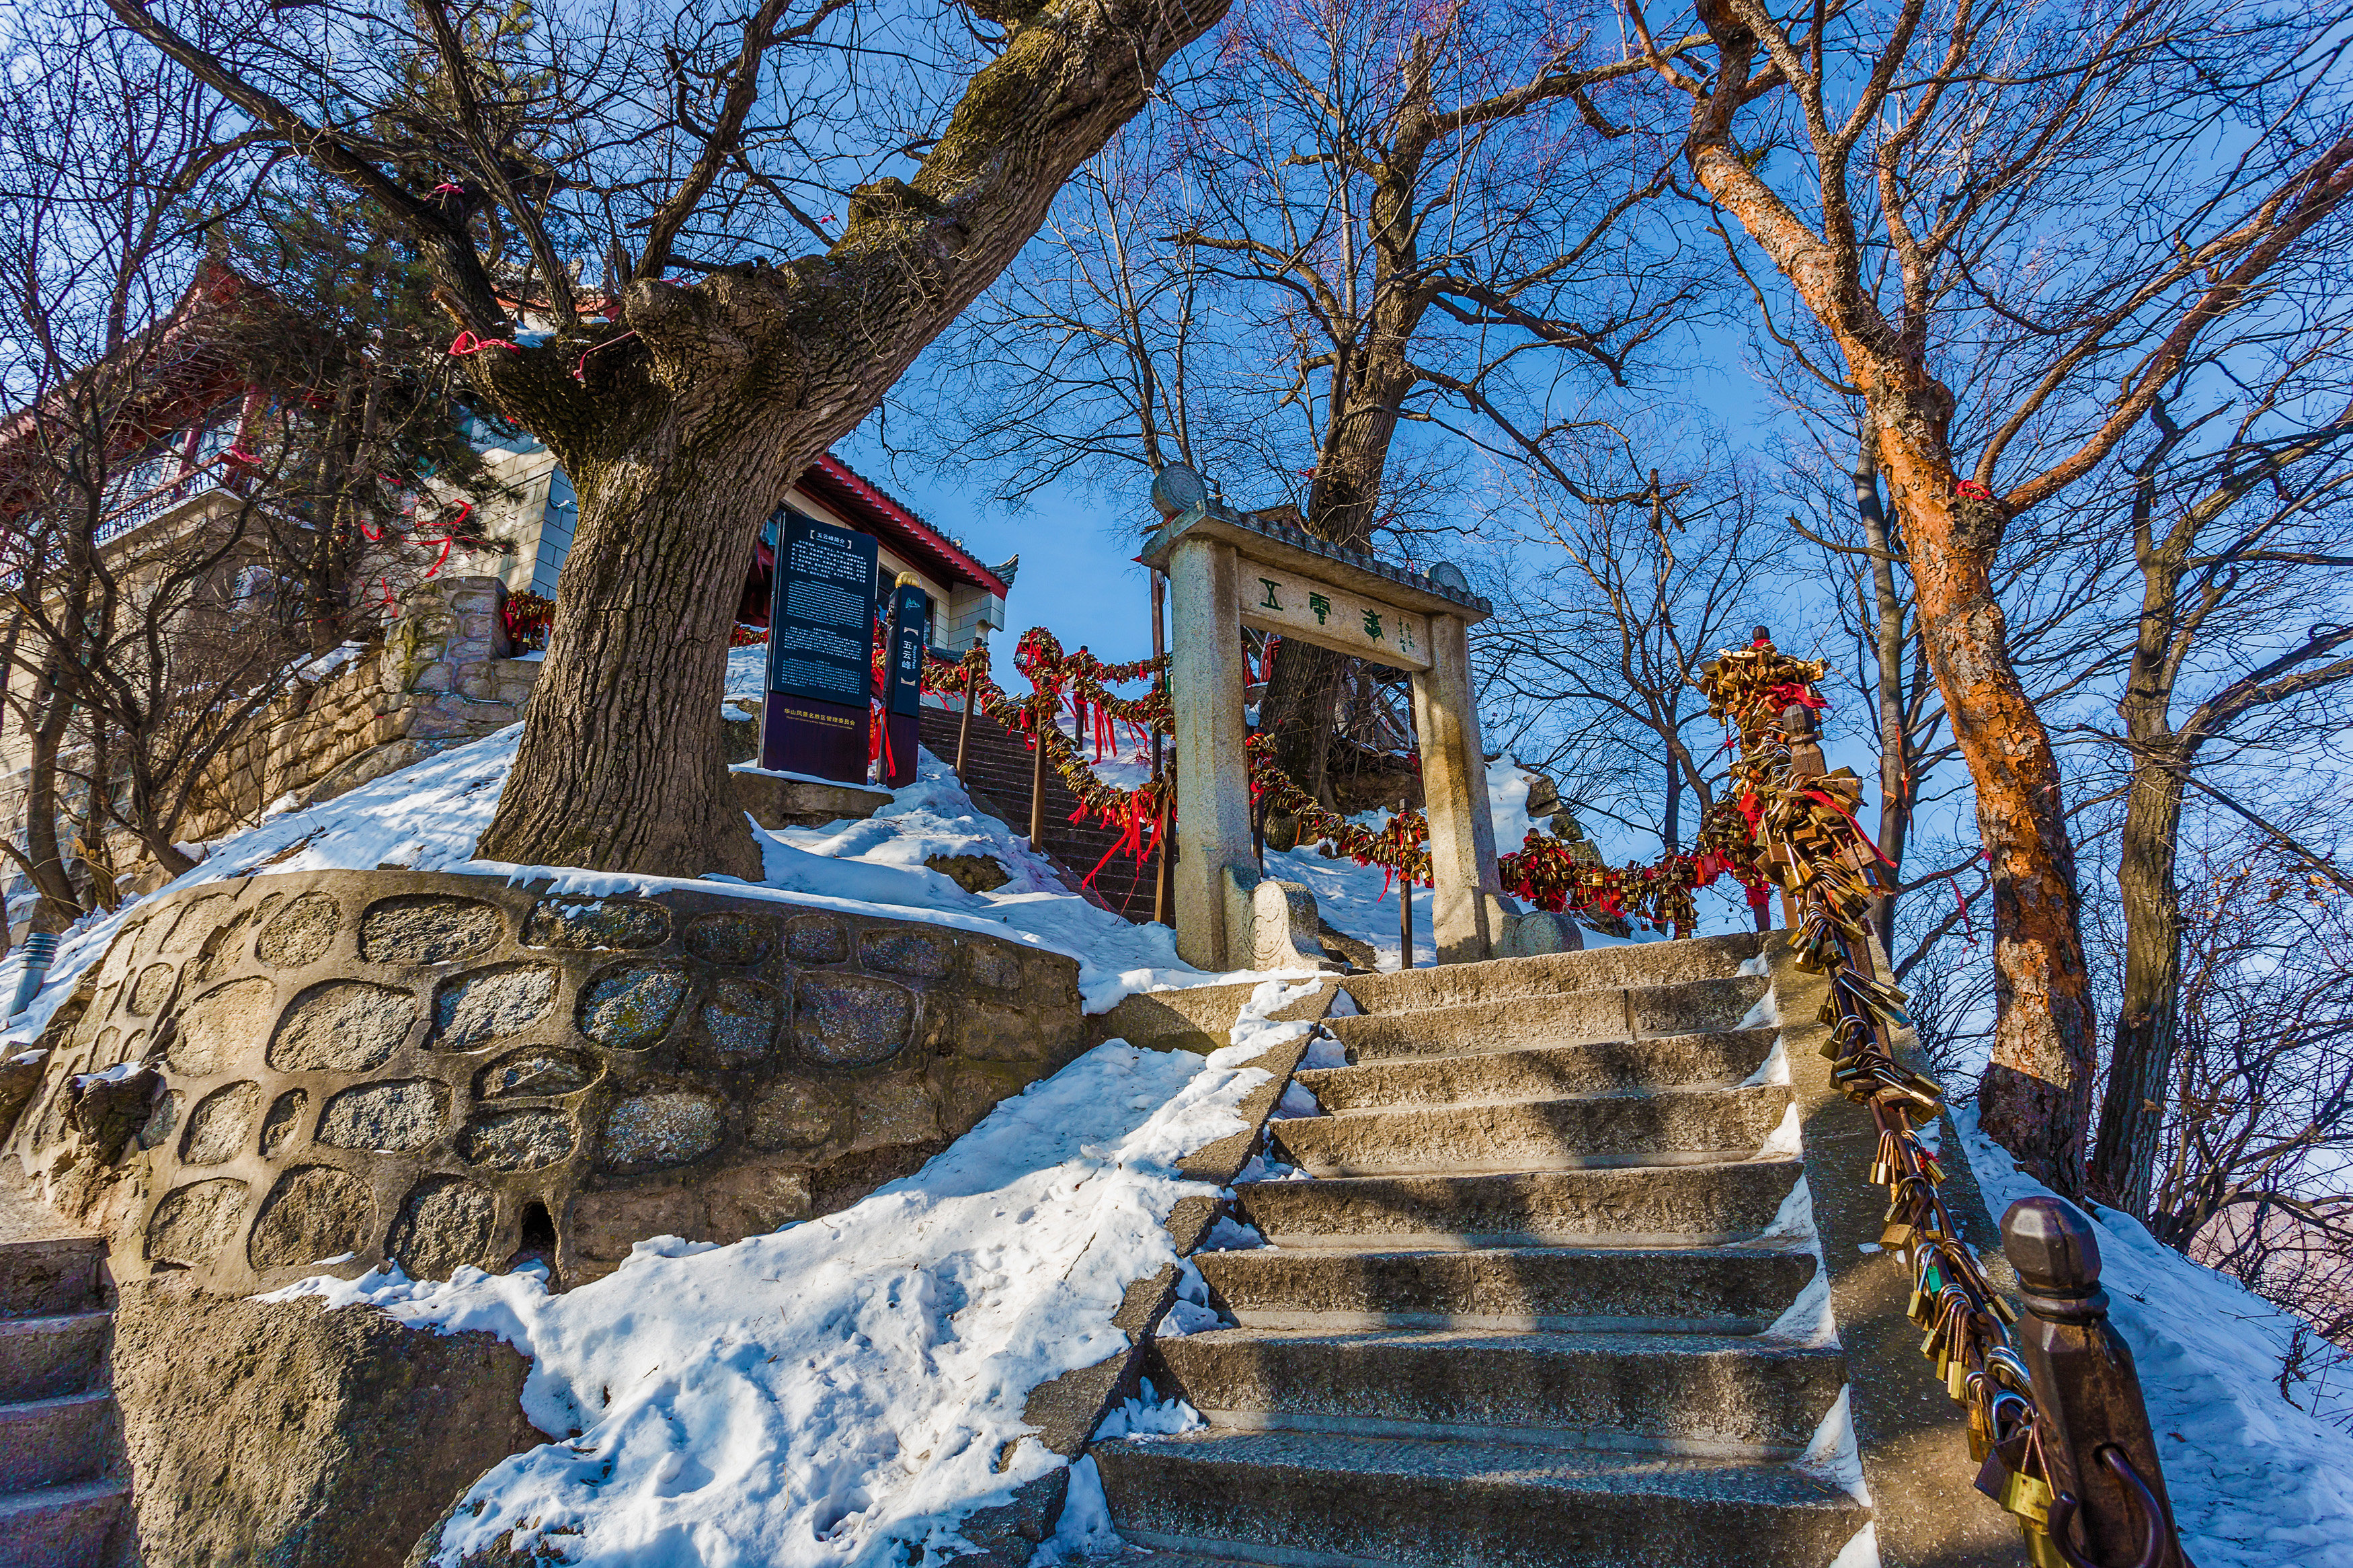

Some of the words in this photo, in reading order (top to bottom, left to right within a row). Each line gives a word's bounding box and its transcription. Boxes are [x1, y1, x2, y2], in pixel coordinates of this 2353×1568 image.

[784, 708, 856, 726] 华山风景名胜区管理委员会
